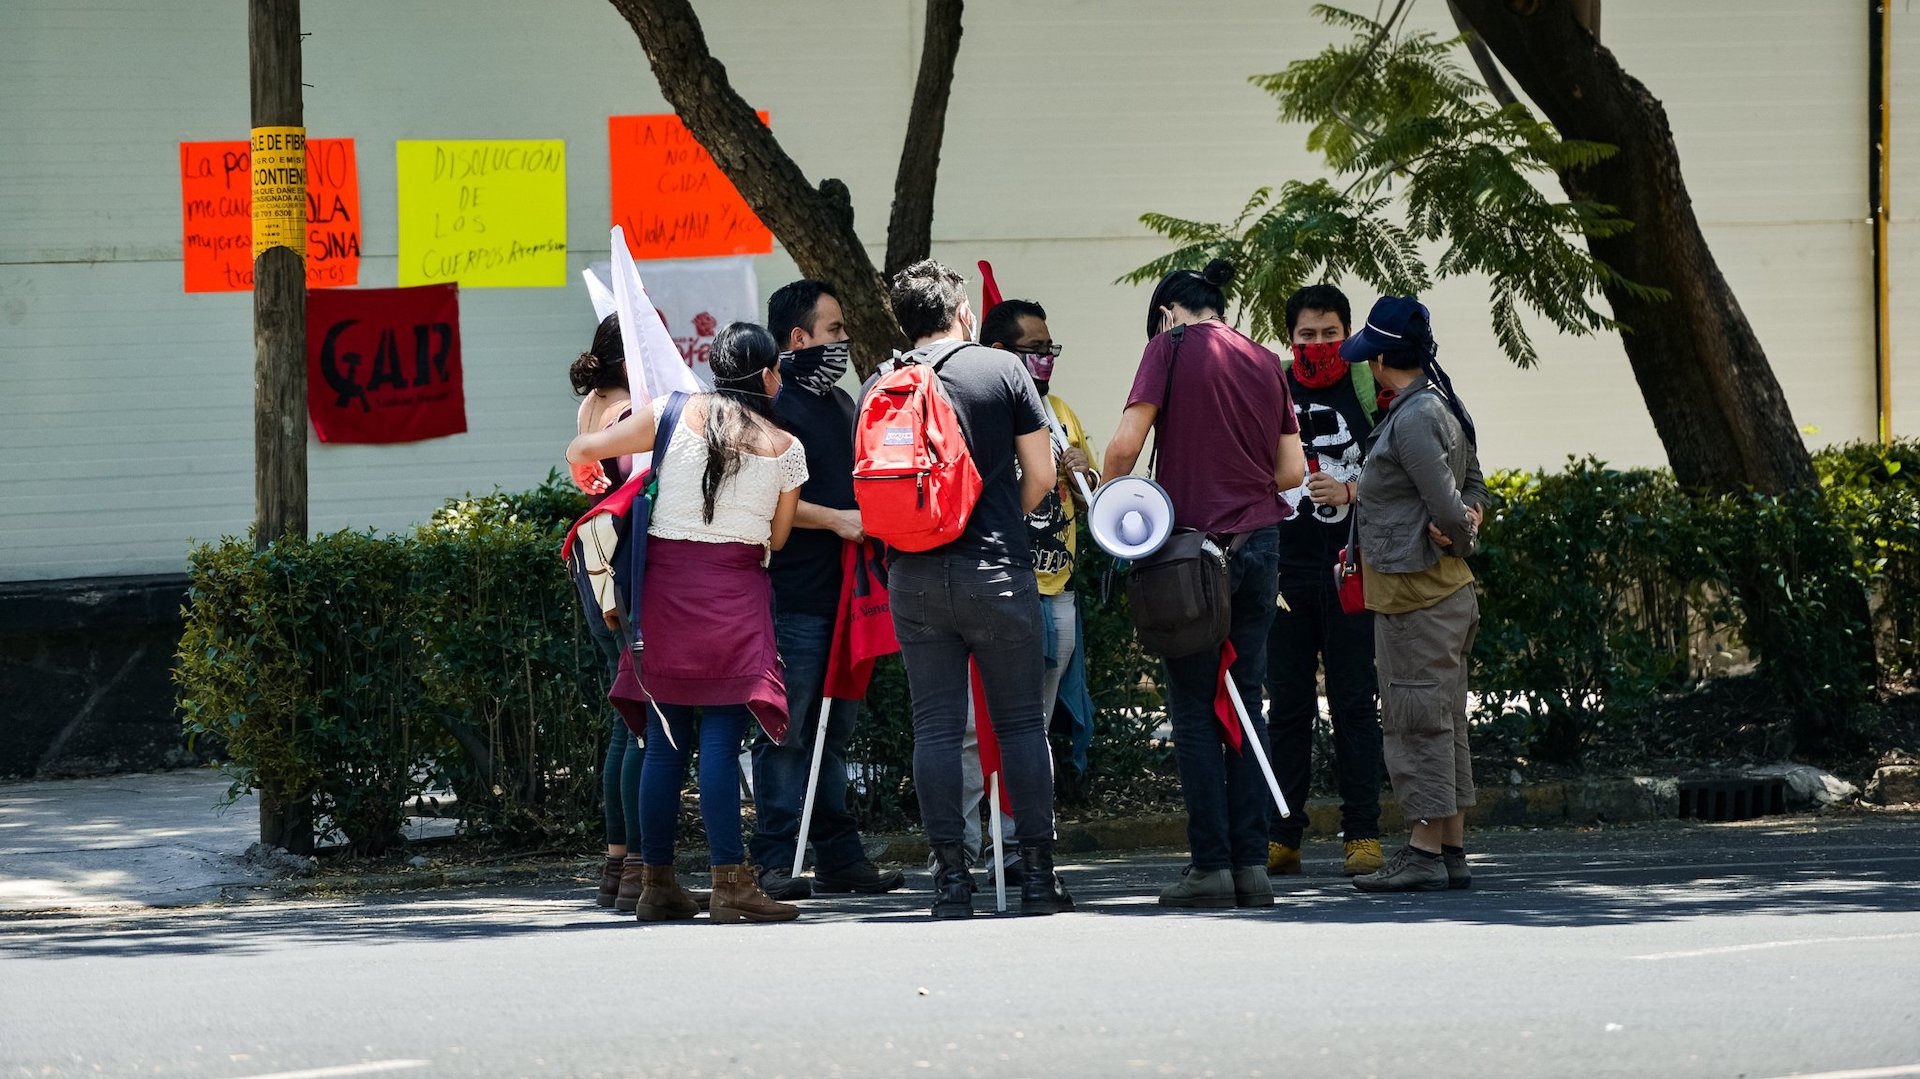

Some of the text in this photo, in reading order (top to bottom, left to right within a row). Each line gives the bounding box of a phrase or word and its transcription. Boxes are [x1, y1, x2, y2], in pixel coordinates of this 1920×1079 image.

[267, 134, 282, 150] DE
[286, 134, 306, 151] FIBR
[185, 146, 216, 179] La
[305, 140, 346, 189] NO
[254, 168, 306, 186] CONTIEN
[459, 185, 486, 212] DE
[434, 212, 487, 239] LOS
